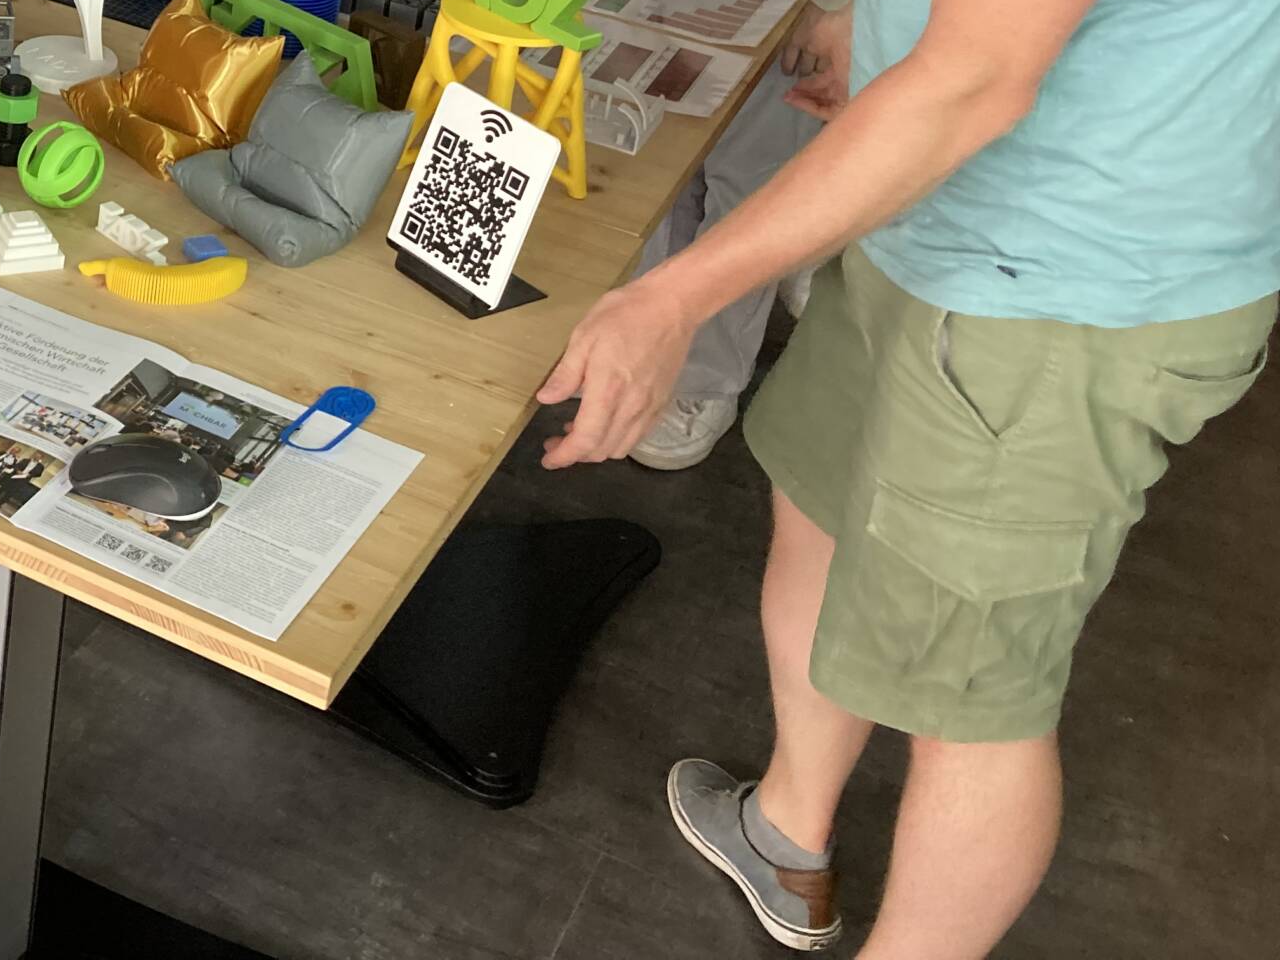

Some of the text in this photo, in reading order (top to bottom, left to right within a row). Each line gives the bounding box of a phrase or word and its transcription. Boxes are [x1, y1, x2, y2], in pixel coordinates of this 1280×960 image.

[26, 331, 87, 361] Förderung
[88, 354, 111, 368] der
[46, 350, 108, 376] Wirtschaft
